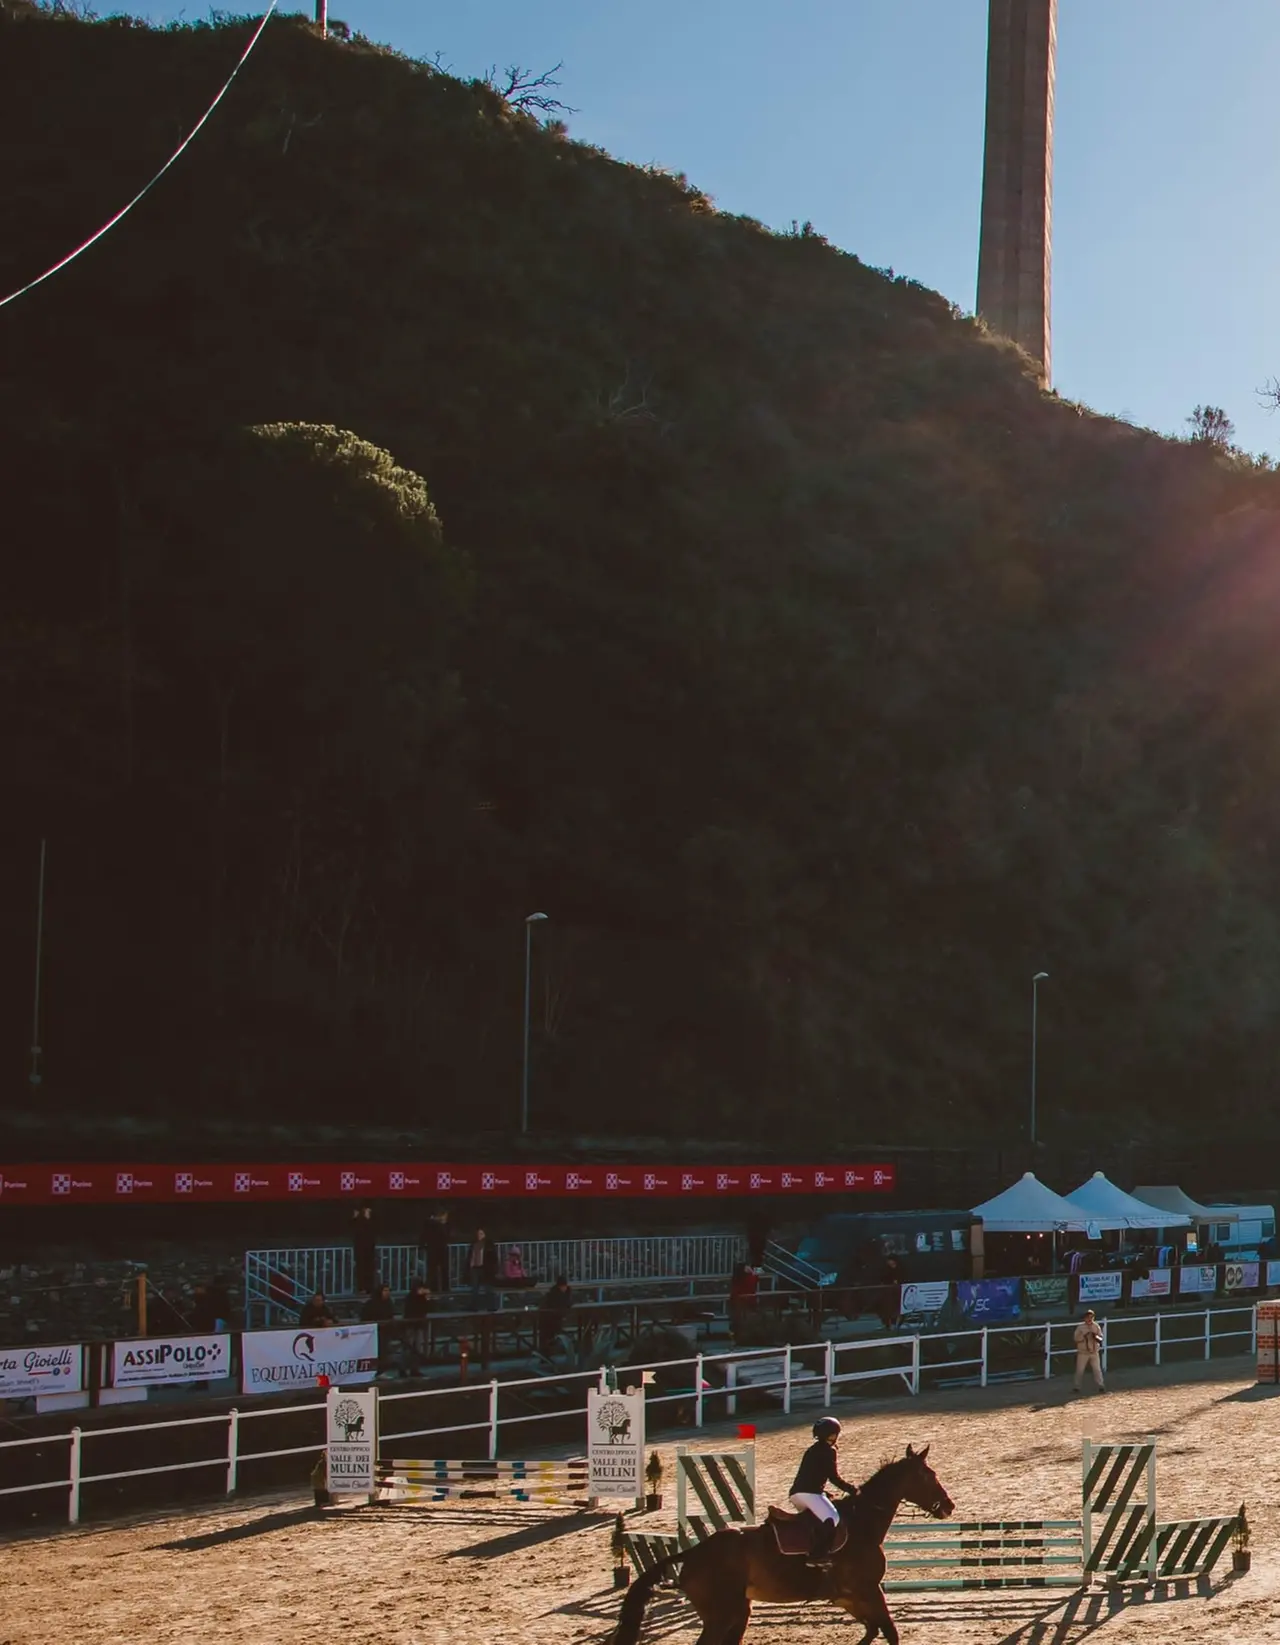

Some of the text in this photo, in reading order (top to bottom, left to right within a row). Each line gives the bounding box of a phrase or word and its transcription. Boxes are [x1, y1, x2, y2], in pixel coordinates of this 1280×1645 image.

[24, 1349, 72, 1372] Gioielli
[330, 1455, 370, 1463] VALLE DEI
[592, 1458, 636, 1466] VALLE DEI
[330, 1464, 370, 1474] MULINI
[592, 1467, 636, 1477] MULINI
